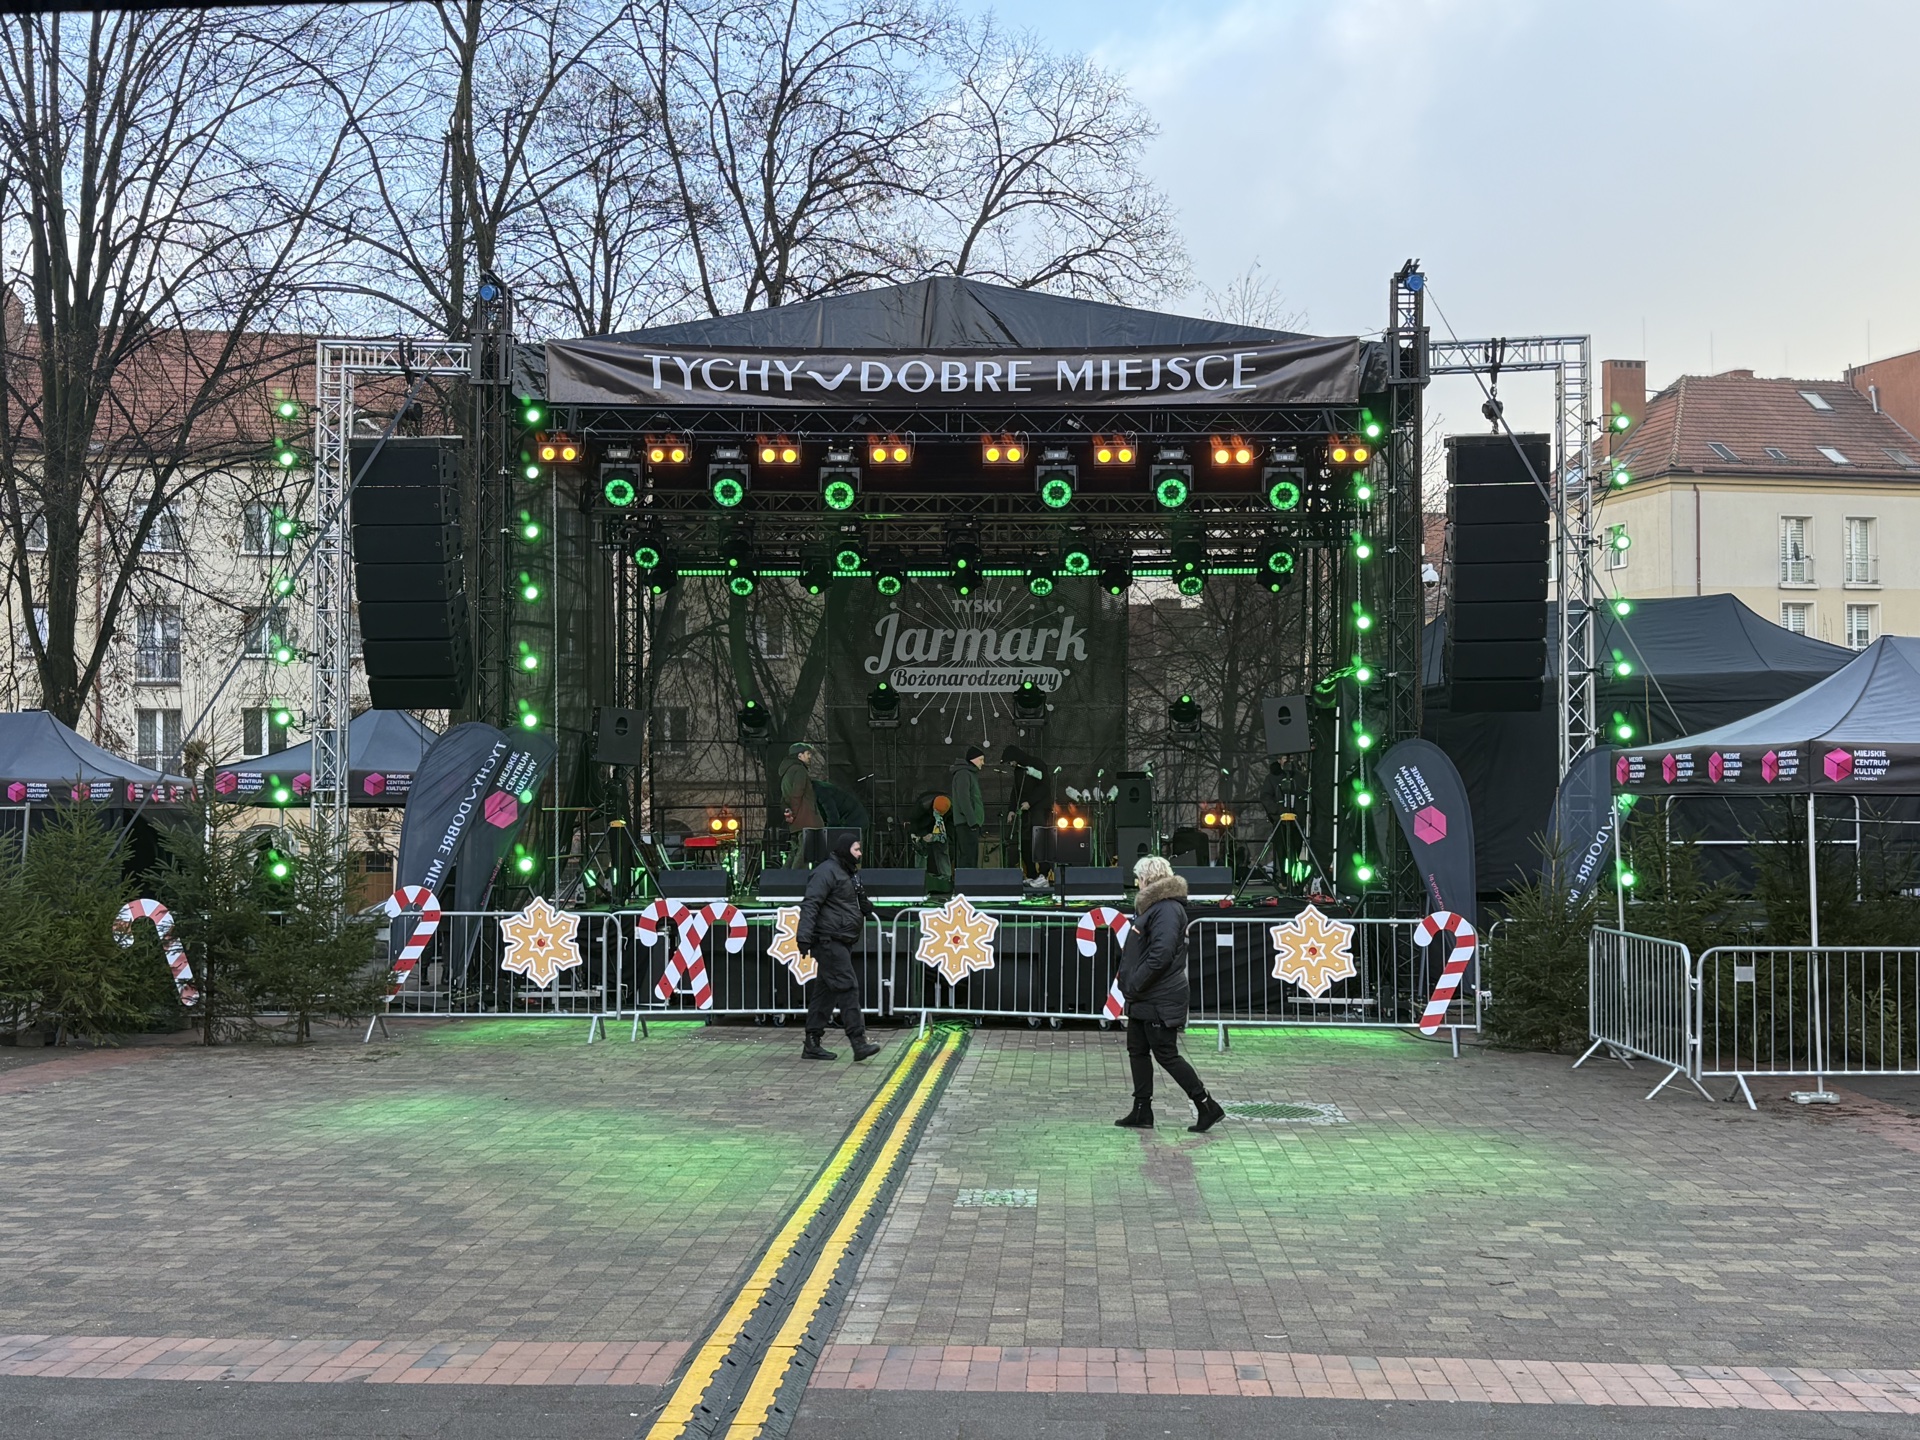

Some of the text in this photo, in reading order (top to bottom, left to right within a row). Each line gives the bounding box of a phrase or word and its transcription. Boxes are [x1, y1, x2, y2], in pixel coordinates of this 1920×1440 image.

[643, 352, 1259, 393] TYCHY DOBRE MIEJSCE
[952, 599, 1002, 613] TYSKI
[864, 612, 1089, 674] Jarmark
[893, 668, 1059, 690] Bożonarodzeniowy
[1853, 749, 1887, 757] MIEJSKIE
[1854, 758, 1890, 767] CENTRUM
[496, 750, 520, 787] MIEJSKIE
[505, 751, 531, 791] CENTRUM
[513, 759, 538, 796] KULTURY
[1853, 767, 1887, 775] KULTURY
